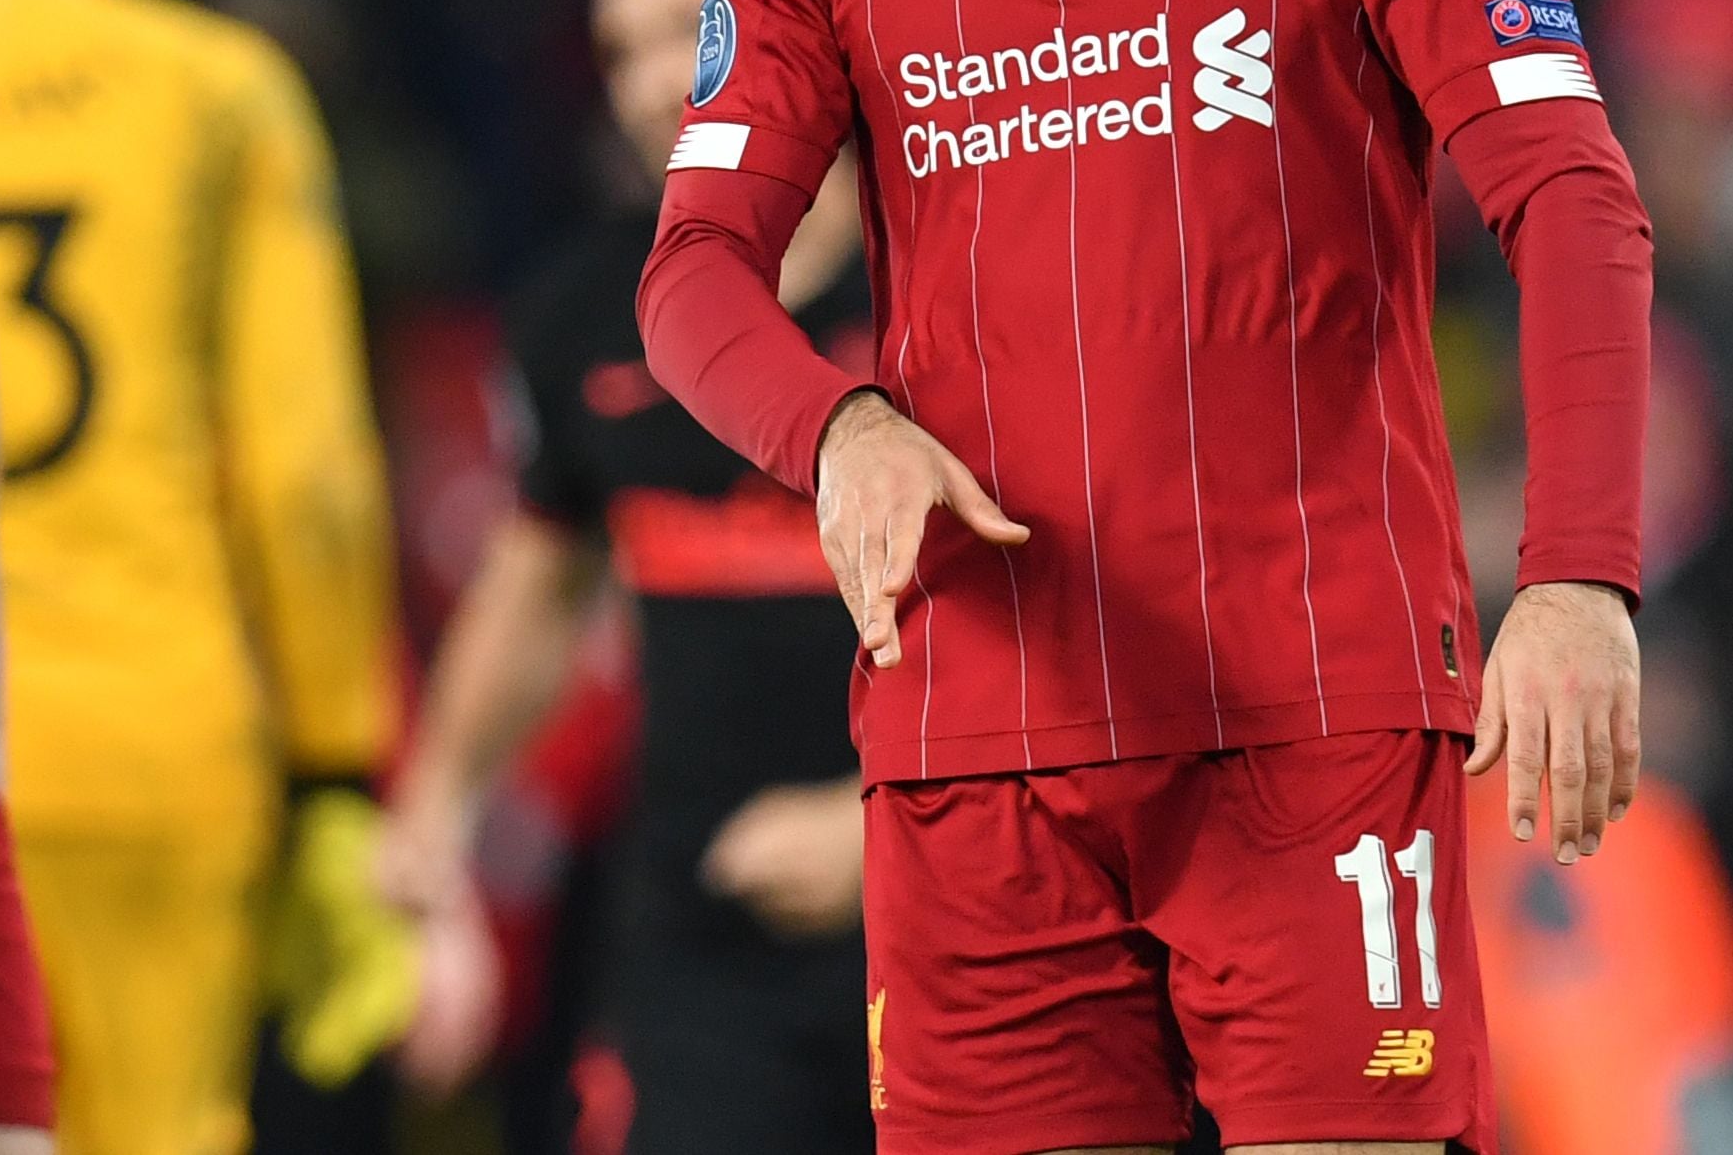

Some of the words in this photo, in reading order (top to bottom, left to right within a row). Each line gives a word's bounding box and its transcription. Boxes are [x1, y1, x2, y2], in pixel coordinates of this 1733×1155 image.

[899, 13, 1169, 108] Standard
[902, 82, 1173, 178] Chartered
[1334, 829, 1442, 1009] 11
